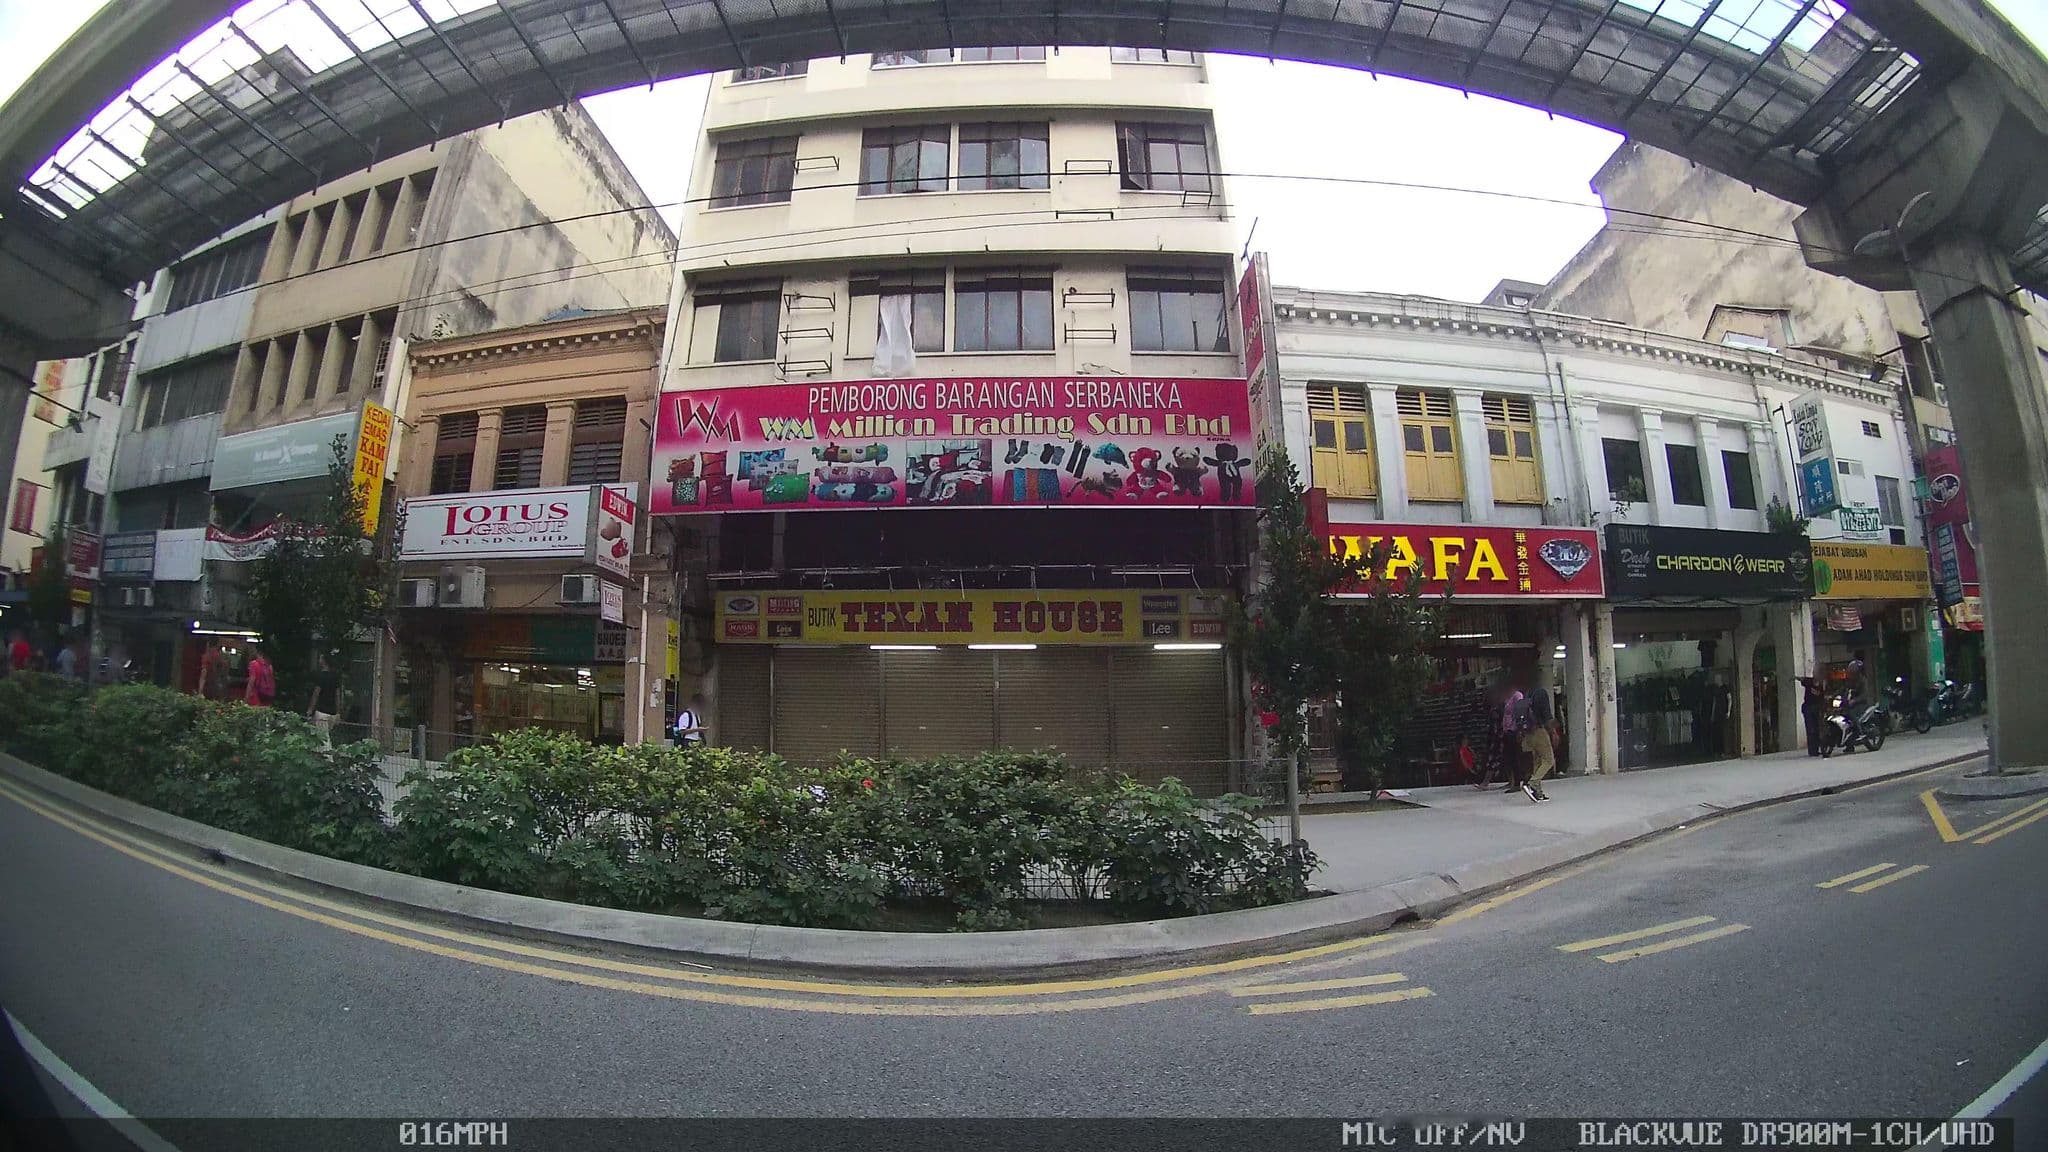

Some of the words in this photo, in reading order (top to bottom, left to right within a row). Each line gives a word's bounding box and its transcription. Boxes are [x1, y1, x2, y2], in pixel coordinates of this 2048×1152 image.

[809, 383, 926, 413] PEMBORONG
[936, 381, 1055, 409] BARANGAN
[1064, 381, 1183, 410] SERBANEKA
[367, 405, 391, 428] KEDAI
[675, 396, 742, 443] WM
[758, 416, 819, 441] WM
[825, 414, 936, 440] Million
[948, 412, 1075, 443] Trading
[1087, 412, 1151, 437] Sdn
[1165, 413, 1231, 438] Bhd
[365, 421, 388, 442] EMAS
[360, 437, 385, 461] KAM
[361, 457, 380, 478] FAI
[441, 502, 569, 536] LOTUS
[472, 520, 568, 535] GROUP
[1618, 528, 1650, 545] BUTIK
[1656, 554, 1732, 572] CHARDON
[1744, 559, 1785, 573] WEAR
[1833, 568, 1852, 581] ADAM
[808, 607, 837, 627] BUTIK
[840, 601, 973, 633] TEXAN
[993, 601, 1123, 633] HOUSE
[1152, 623, 1171, 634] Lee
